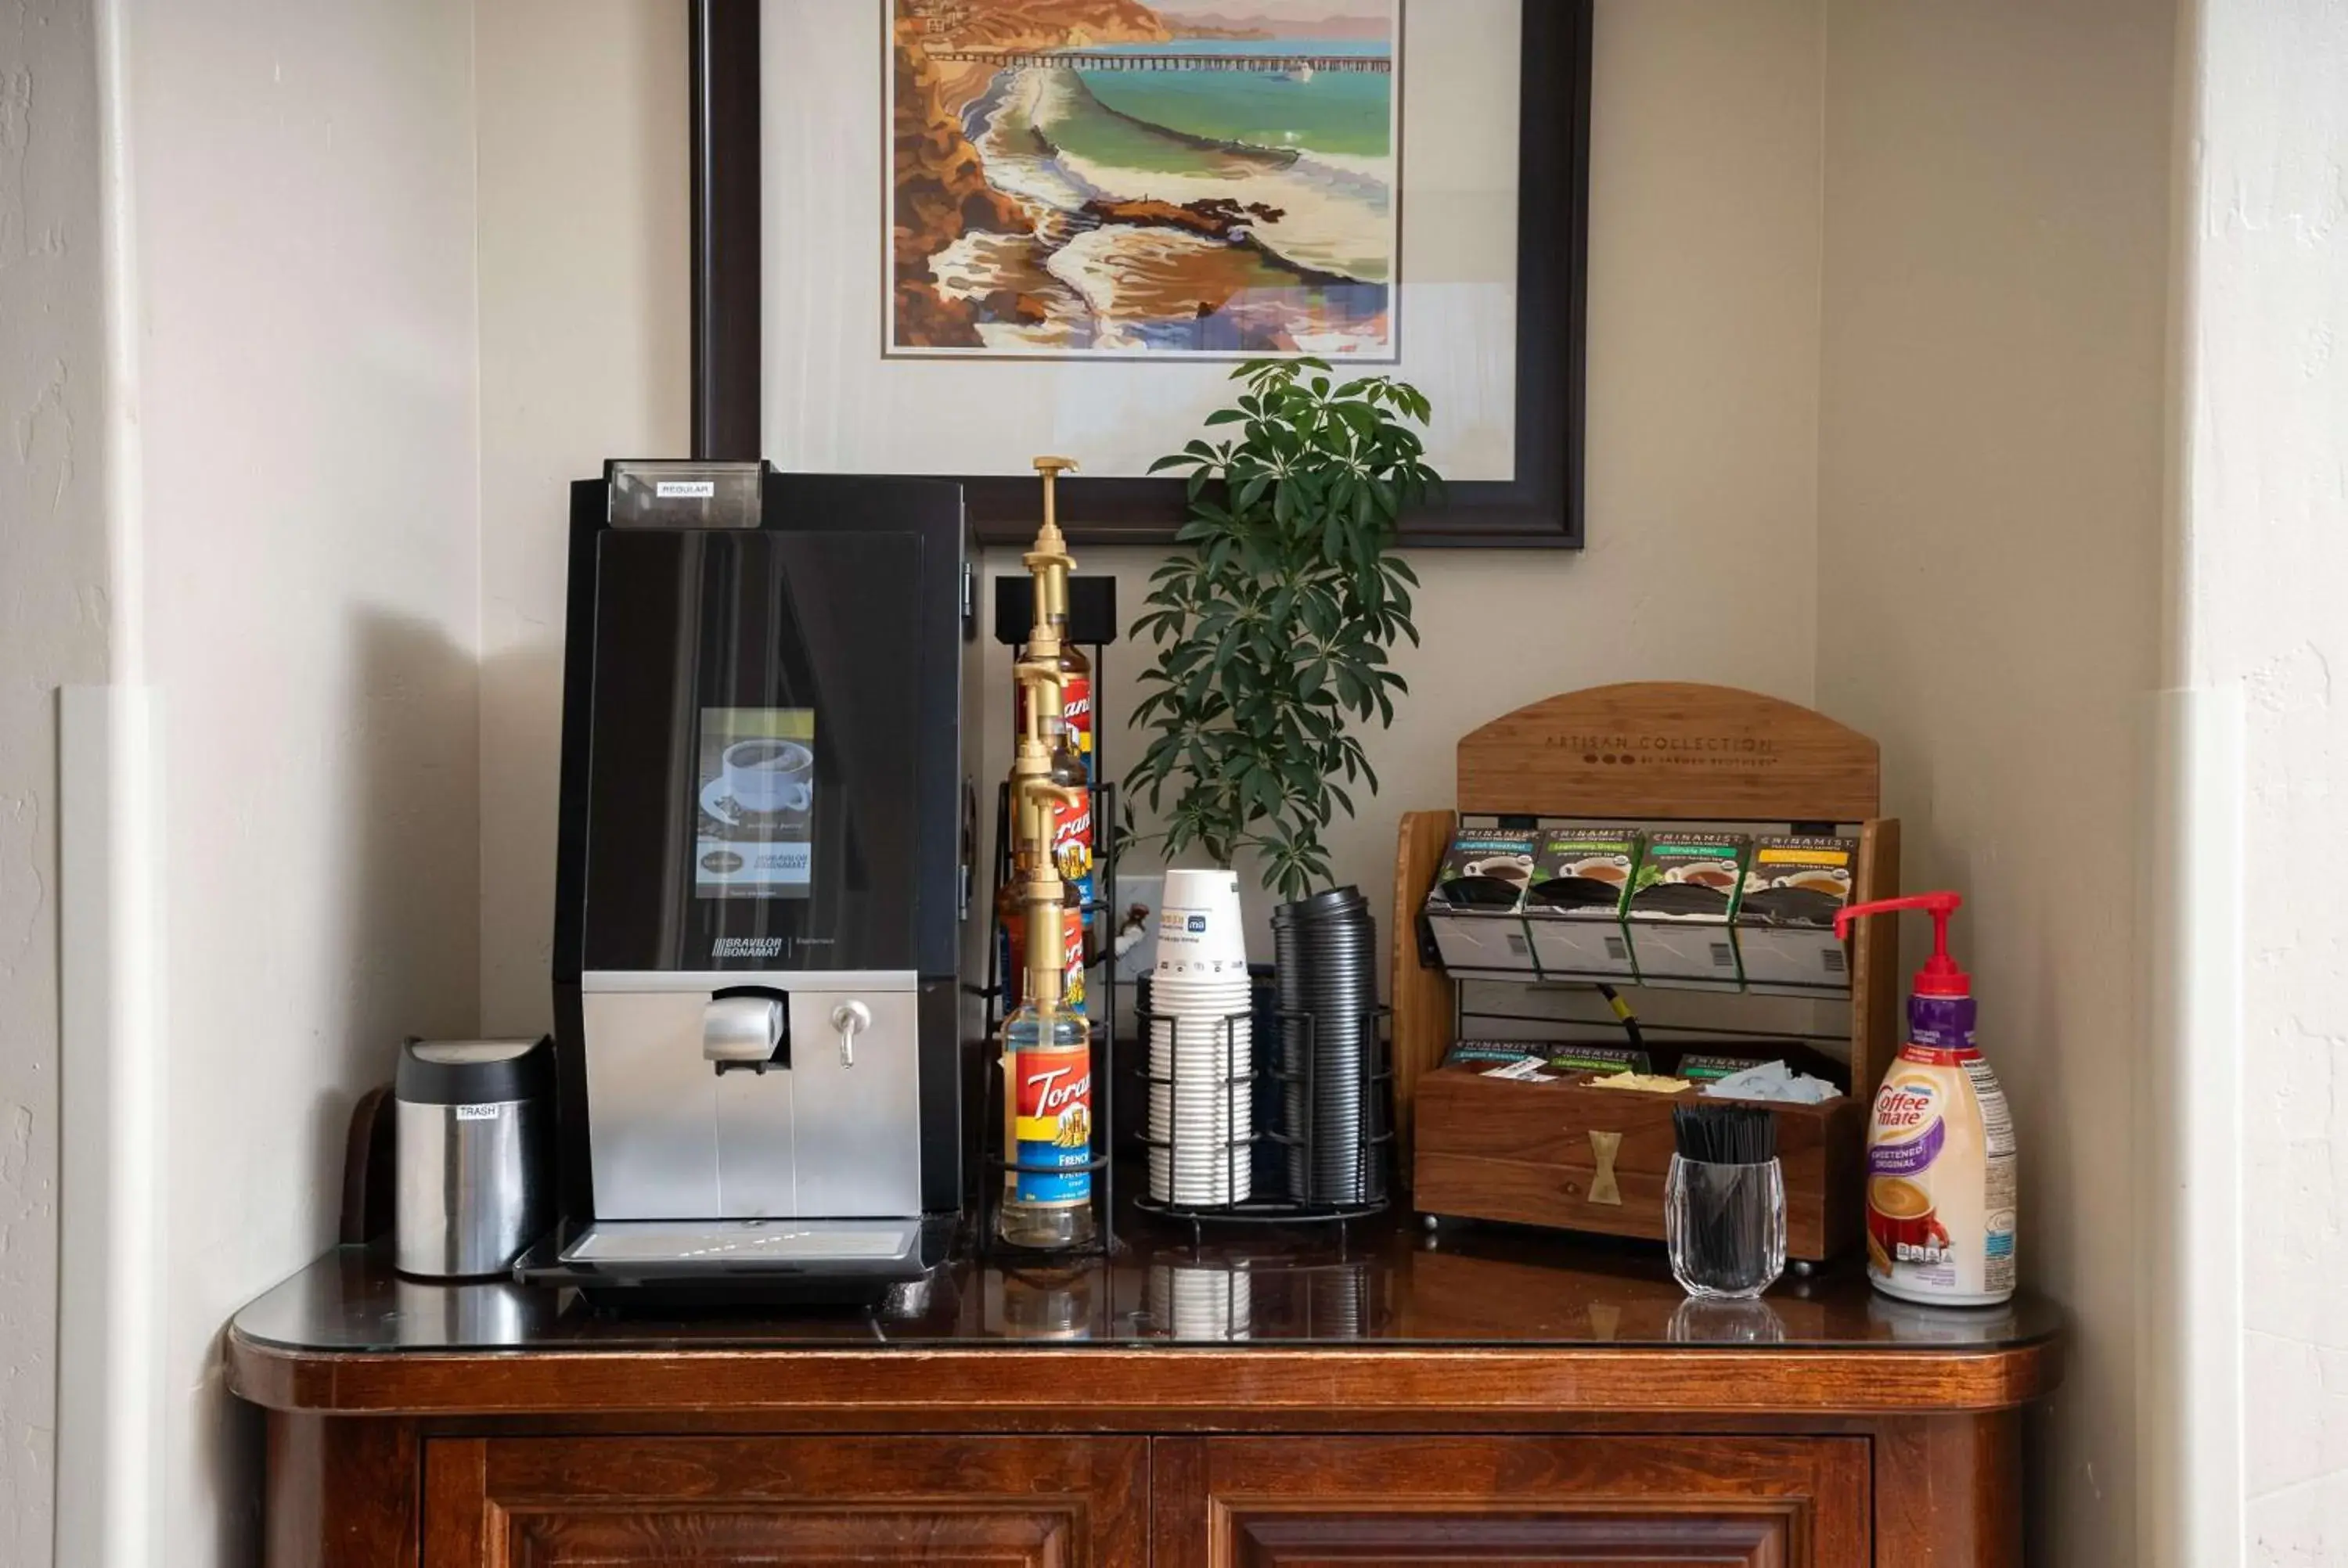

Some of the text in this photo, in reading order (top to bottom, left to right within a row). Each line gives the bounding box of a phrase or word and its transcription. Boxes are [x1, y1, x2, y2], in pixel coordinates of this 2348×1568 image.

[1545, 735, 1772, 753] ARTISAN COLLECTION
[724, 938, 782, 948] BRAVILOR
[722, 947, 779, 958] BONAMAT
[1877, 1084, 1929, 1113] Coffee
[461, 1106, 495, 1116] TRASH
[1878, 1111, 1921, 1126] mate
